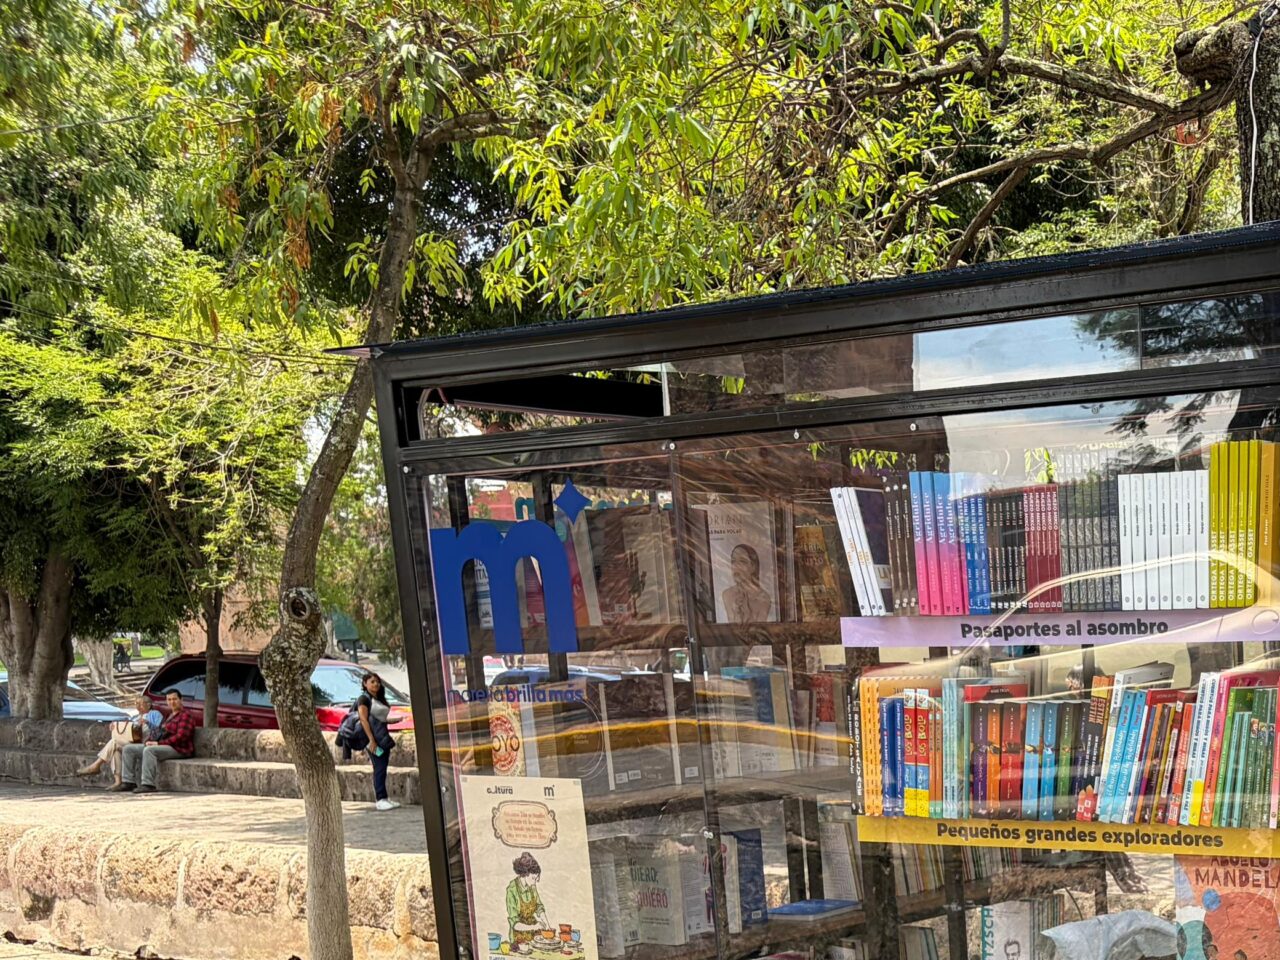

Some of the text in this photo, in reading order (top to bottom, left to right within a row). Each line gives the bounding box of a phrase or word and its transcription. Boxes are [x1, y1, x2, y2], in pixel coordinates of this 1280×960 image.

[912, 493, 921, 544] Agridulce
[924, 493, 934, 543] Agridulce
[936, 493, 946, 544] Agridulce
[430, 519, 578, 654] m
[960, 618, 1168, 640] Pasaportes al asombro
[937, 822, 1223, 848] Pequeños grandes exploradores
